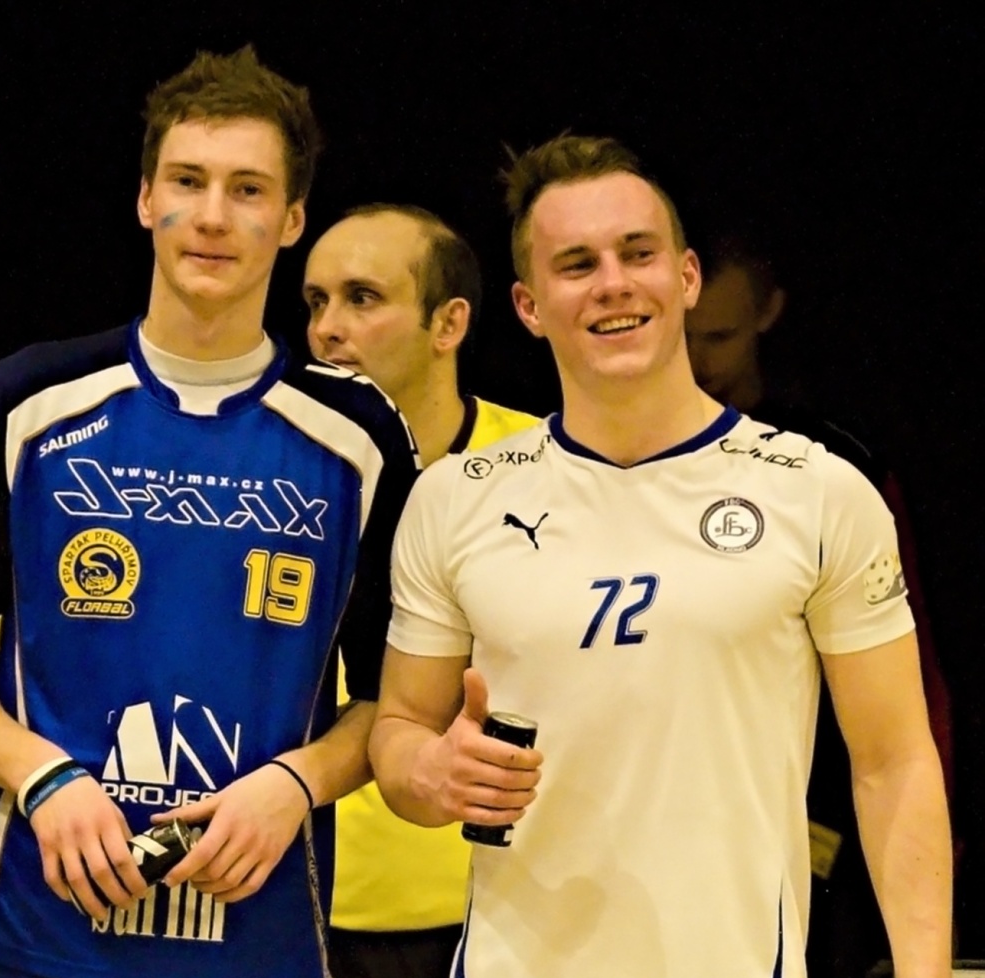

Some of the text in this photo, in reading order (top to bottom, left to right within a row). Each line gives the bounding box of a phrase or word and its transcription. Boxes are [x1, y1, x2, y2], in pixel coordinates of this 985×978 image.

[39, 415, 109, 458] SALMING
[112, 466, 264, 491] www.j-max.cz
[62, 534, 90, 584] SPARTAK
[243, 549, 315, 627] 19
[579, 572, 660, 649] 72
